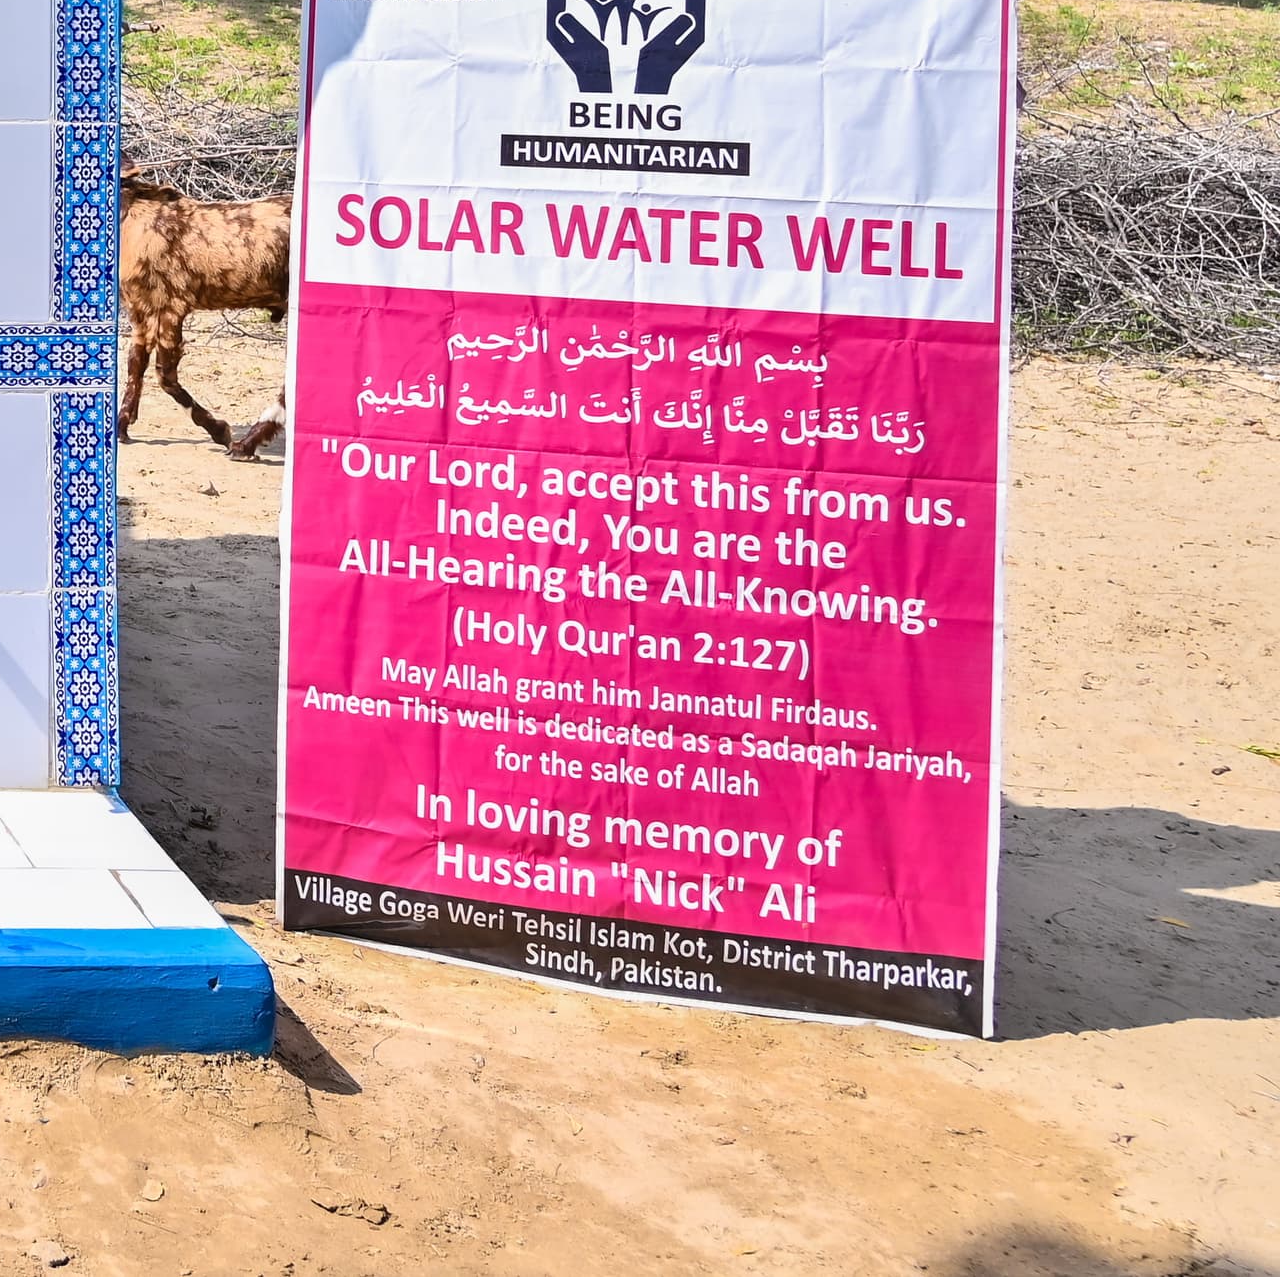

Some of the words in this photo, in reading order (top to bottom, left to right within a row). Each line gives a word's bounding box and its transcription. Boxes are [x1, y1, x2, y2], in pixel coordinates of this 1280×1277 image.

[514, 141, 738, 169] HUMANITARIAN
[570, 102, 681, 131] BEING
[336, 194, 525, 256] SOLAR
[546, 203, 764, 269] WATER
[786, 215, 963, 279] WELL
[322, 437, 416, 481] "Our
[429, 449, 528, 498] Lord,
[542, 468, 678, 511] accept
[691, 471, 770, 512] this
[784, 477, 889, 522] from
[905, 497, 966, 527] us.
[437, 499, 589, 554] Indeed,
[603, 514, 678, 555] You
[693, 531, 761, 562] are
[774, 528, 846, 569] the
[339, 539, 567, 603] All-Hearing
[578, 561, 648, 602] the
[660, 570, 938, 635] All-Knowing.
[453, 606, 547, 655] (Holy
[558, 620, 680, 661] Qur'an
[693, 632, 809, 680] 2:127)
[382, 657, 437, 691] May
[443, 664, 508, 694] Allah
[515, 678, 584, 703] grant
[593, 678, 641, 709] him
[649, 686, 762, 720] Jannatul
[771, 697, 877, 731] Firdaus.
[303, 685, 393, 718] Ameen
[398, 696, 449, 725] This
[456, 706, 511, 732] well
[517, 709, 538, 735] is
[544, 713, 675, 750] dedicated
[682, 733, 710, 753] as
[718, 737, 733, 755] a
[741, 732, 857, 771] Sadaqah
[864, 745, 971, 784] Jariyah,
[495, 744, 533, 772] for
[539, 750, 583, 779] the
[591, 758, 649, 786] sake
[657, 764, 685, 789] of
[691, 767, 759, 797] Allah
[417, 784, 452, 822] In
[467, 789, 591, 848] loving
[605, 816, 784, 870] memory
[797, 829, 843, 867] of
[437, 841, 595, 897] Hussain
[611, 862, 745, 913] "Nick"
[759, 883, 816, 923] Ali
[295, 875, 372, 915] Village
[379, 891, 439, 922] Goga
[447, 901, 504, 930] Weri
[512, 911, 581, 943] Tehsil
[590, 922, 654, 952] Islam
[664, 931, 713, 964] Kot,
[723, 939, 816, 974] District
[823, 950, 972, 996] Tharparkar,
[525, 943, 602, 983] Sindh,
[611, 955, 722, 993] Pakistan.
